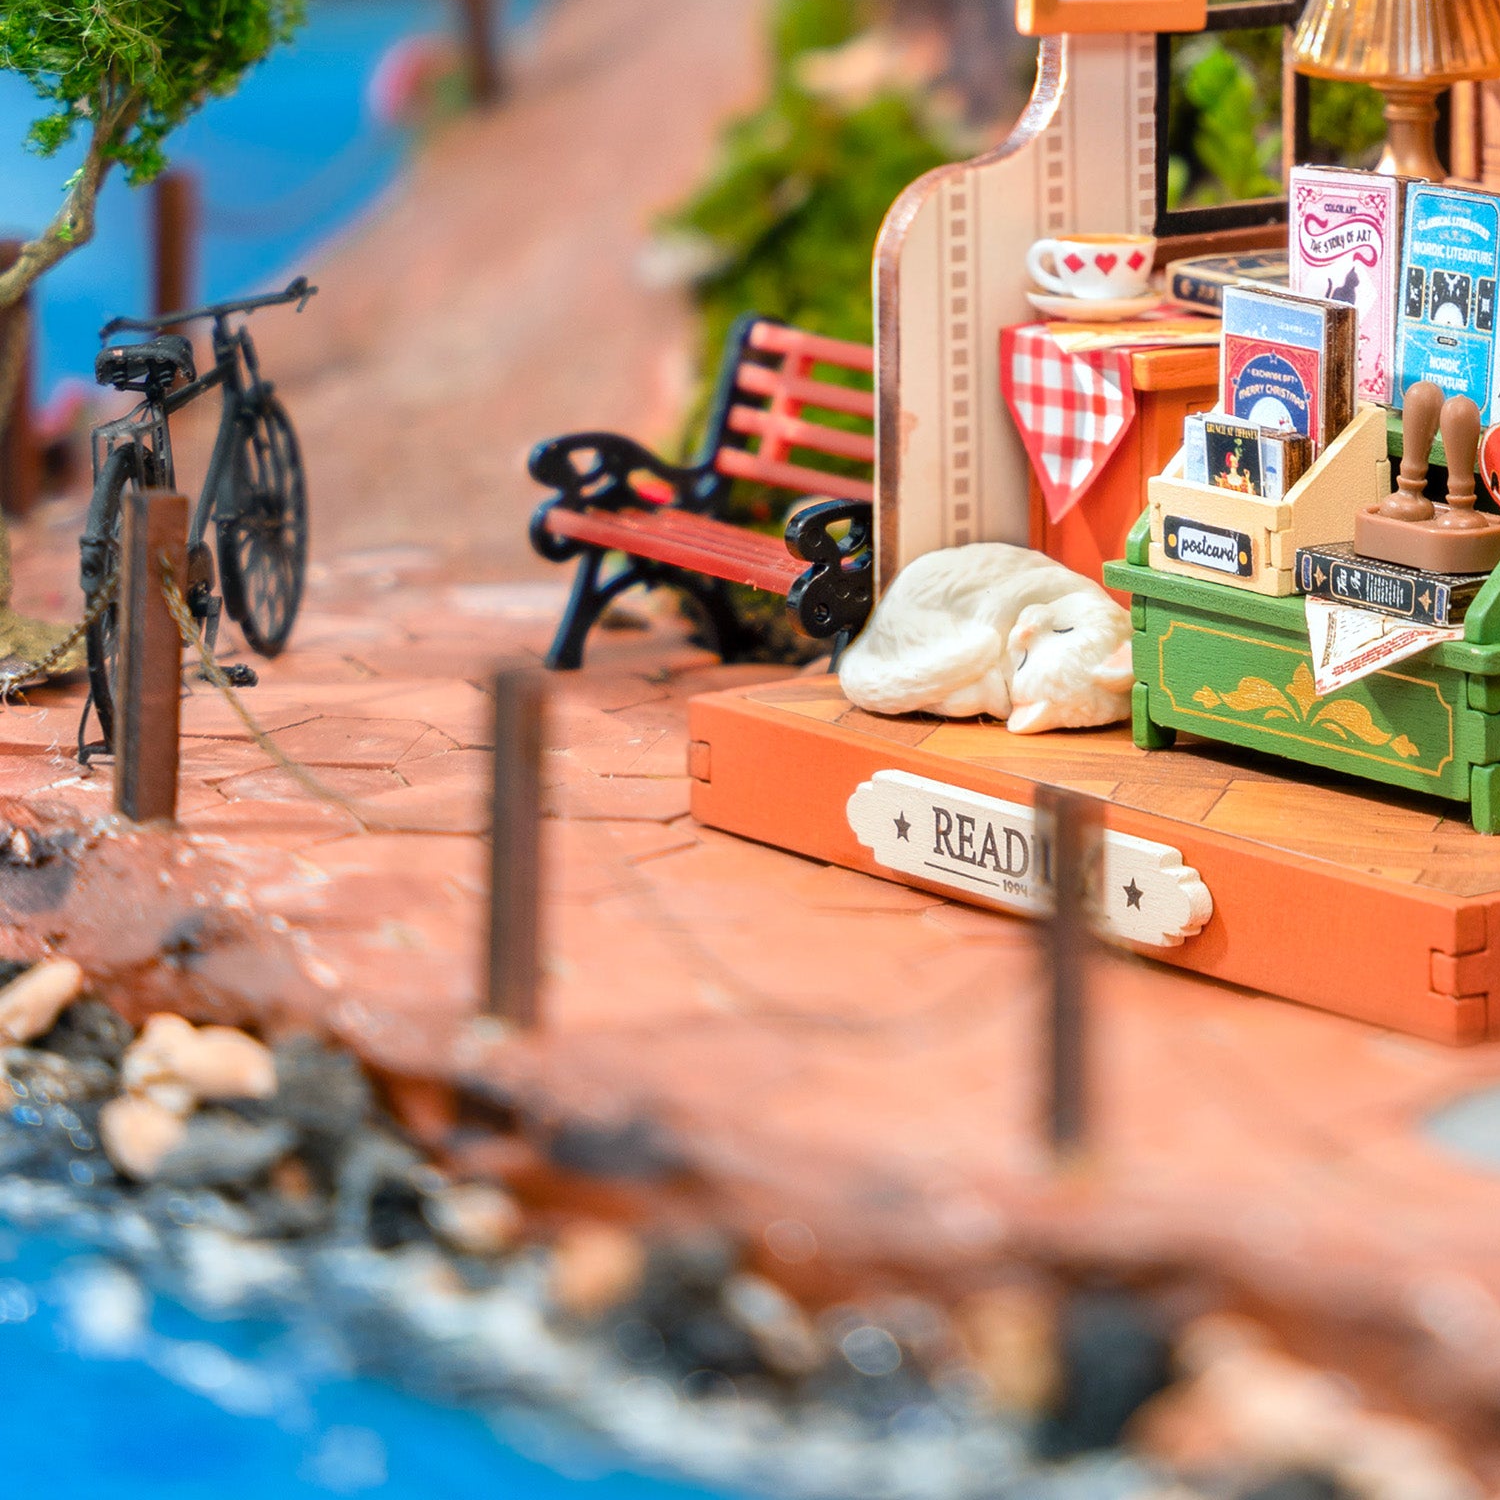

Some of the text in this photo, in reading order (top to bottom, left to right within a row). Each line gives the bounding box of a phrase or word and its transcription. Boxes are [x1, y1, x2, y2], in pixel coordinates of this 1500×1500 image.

[1413, 241, 1494, 265] NORDIC LITERATURE
[1181, 535, 1237, 563] postcard
